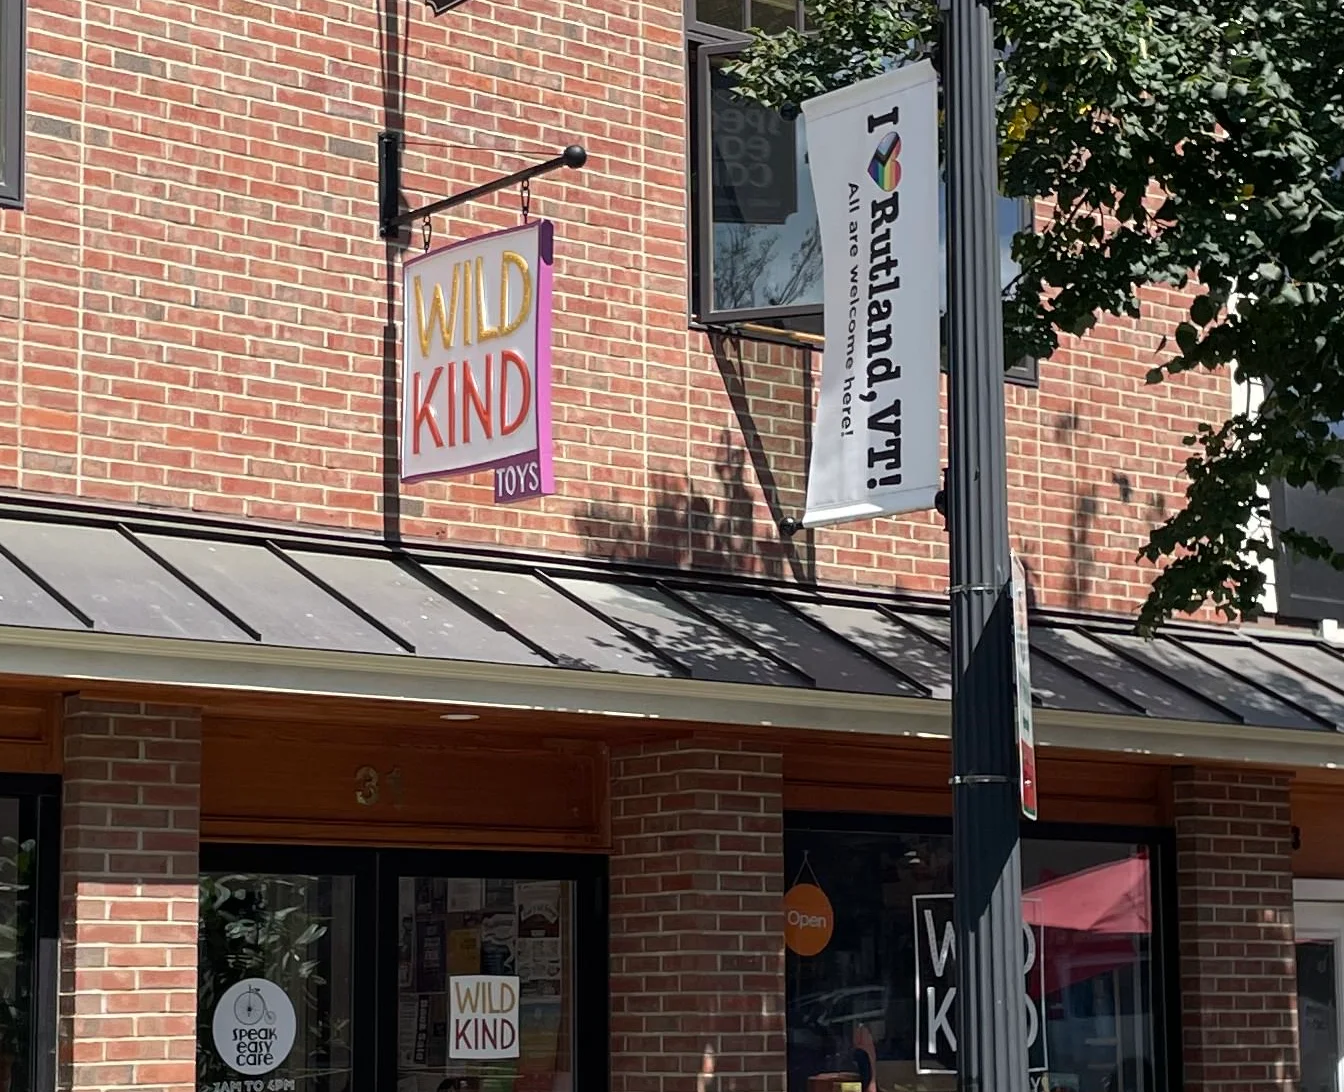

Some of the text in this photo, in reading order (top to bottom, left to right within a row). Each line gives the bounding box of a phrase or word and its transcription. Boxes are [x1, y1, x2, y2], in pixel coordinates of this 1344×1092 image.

[867, 106, 900, 134] I
[413, 251, 532, 358] WILD
[840, 182, 860, 437] All are welcome here!
[413, 349, 532, 455] KIND
[496, 462, 539, 497] TOYS
[787, 910, 827, 930] Open
[455, 982, 516, 1014] WILD
[455, 1018, 516, 1050] KIND
[244, 1080, 264, 1092] TO
